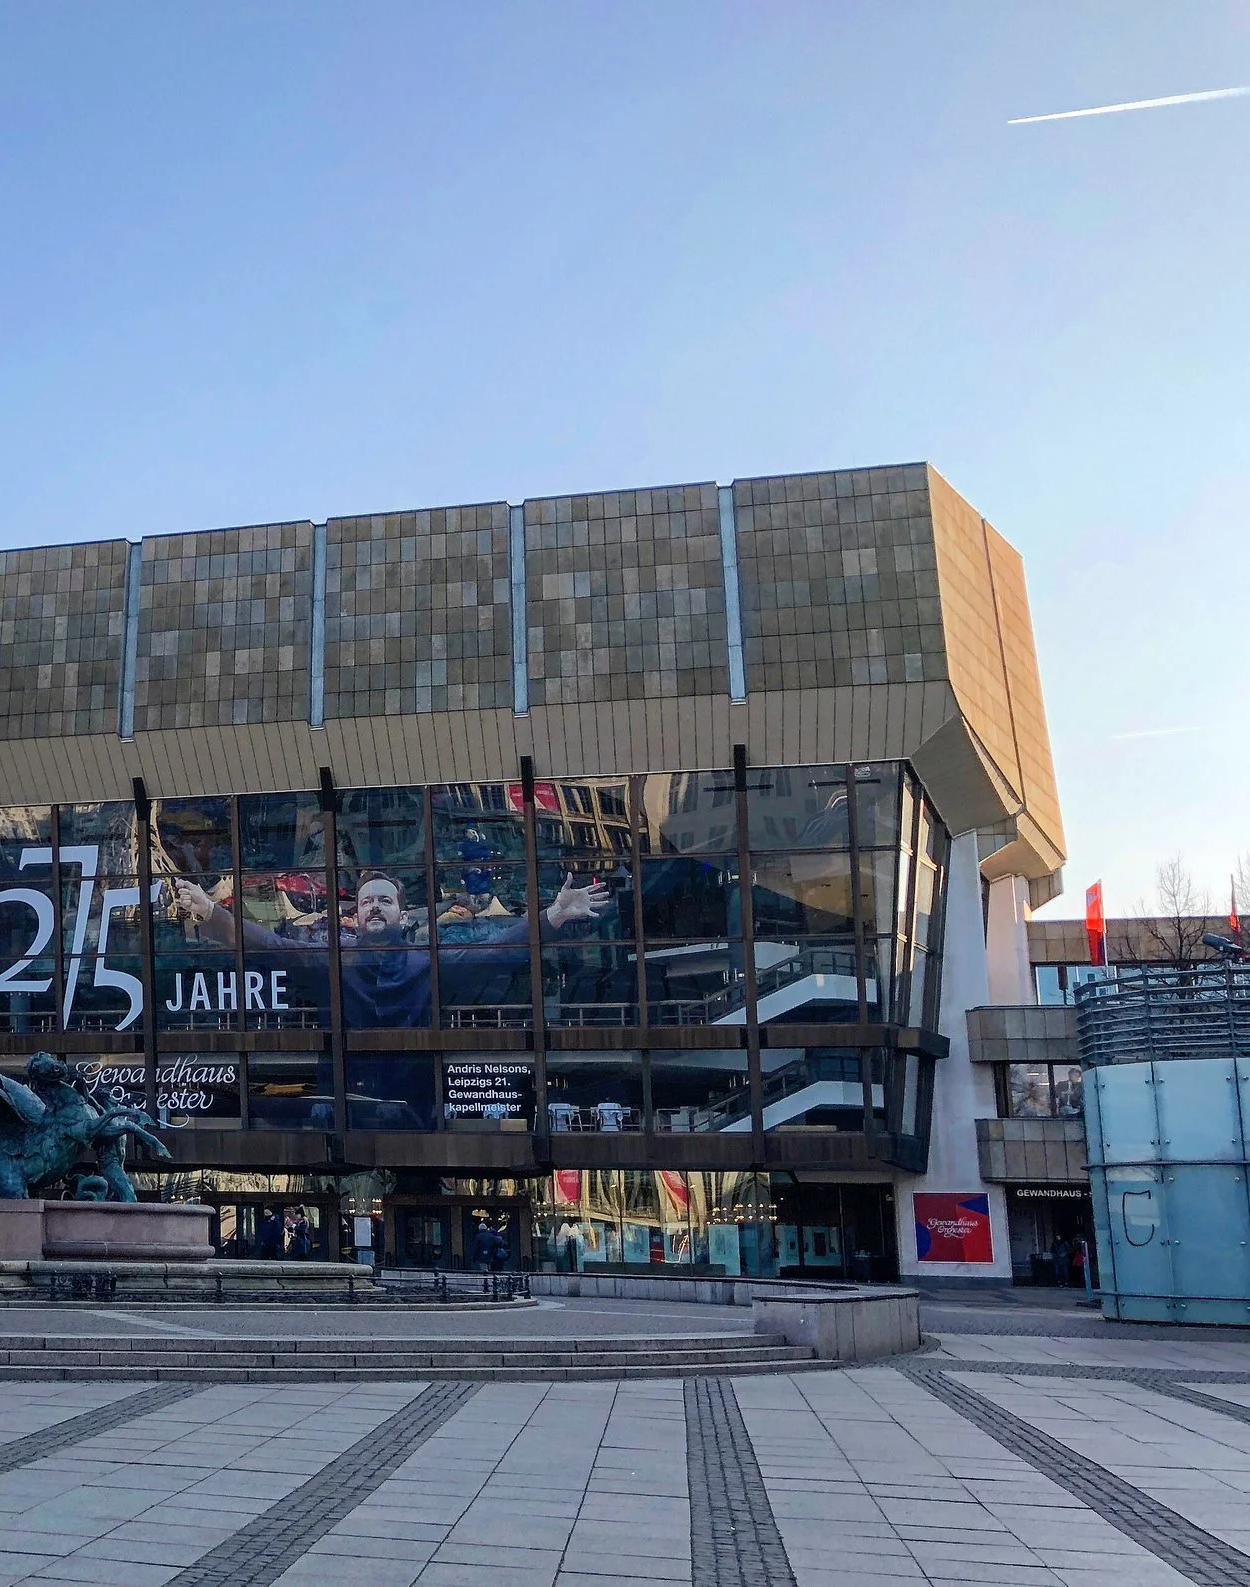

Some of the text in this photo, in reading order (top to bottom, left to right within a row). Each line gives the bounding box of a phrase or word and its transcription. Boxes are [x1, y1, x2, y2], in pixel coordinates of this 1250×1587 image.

[166, 971, 289, 1012] JAHRE
[447, 1064, 531, 1075] Andris Nelsons,
[448, 1077, 511, 1088] Leipzigs 21.
[448, 1089, 523, 1099] Gewandhaus-
[449, 1102, 522, 1113] kapellmeister
[1016, 1189, 1082, 1197] GEWANDHAUS
